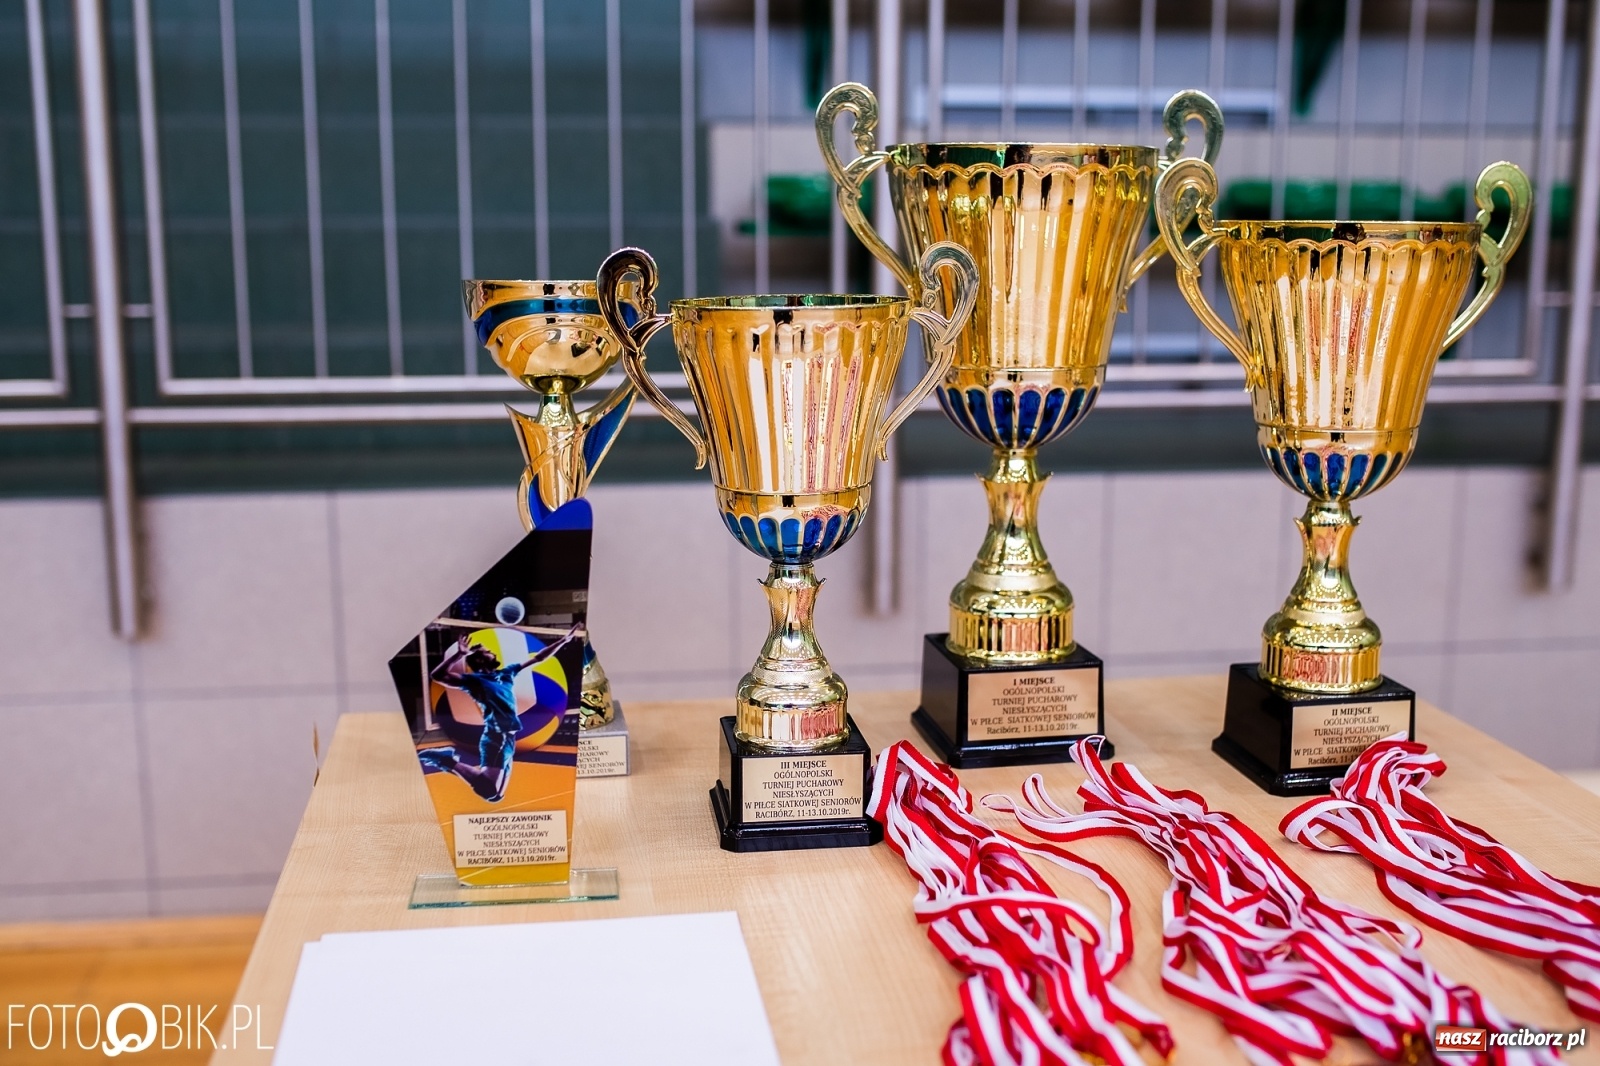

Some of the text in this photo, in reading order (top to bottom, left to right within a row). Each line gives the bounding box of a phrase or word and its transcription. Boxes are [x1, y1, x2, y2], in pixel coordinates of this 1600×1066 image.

[1019, 677, 1055, 686] MIEJSCE
[1003, 686, 1065, 695] OGÓLNOPOLSKI
[992, 695, 1077, 706] TURNIEJ PUCHAROWY
[1003, 705, 1067, 715] NIESŁYSZĄCYCH
[1340, 707, 1372, 715] MIEJSCE
[1008, 715, 1052, 723] SIATKOWEJ
[1053, 712, 1096, 721] SENIORÓW
[1324, 716, 1379, 726] OGÓLNOPOLSKI
[987, 723, 1079, 735] Racibórz, 11-13.10.2019r.
[1314, 725, 1390, 736] TURNIEJ PUCHAROWY
[1323, 735, 1380, 745] NIESŁYSZĄCYCH
[793, 760, 827, 769] MIEJSCE
[1308, 756, 1338, 765] Racibórz,
[774, 770, 833, 779] OGÓLNOPOLSKI
[797, 779, 844, 788] PUCHAROWY
[773, 789, 834, 799] NIESŁYSZĄCYCH
[754, 801, 775, 809] PIŁCE
[778, 799, 819, 808] SIATKOWEJ
[821, 796, 862, 805] SENIORÓW
[755, 808, 851, 819] RACIBÓRZ, 11-13.10.2019r.
[468, 814, 552, 824] NAJLEPSZY ZAWODNIK
[483, 823, 538, 831] OGÓLNOPOLSKI
[483, 839, 540, 848] NIESŁYSZĄCYCH
[488, 848, 527, 856] SIATKOWEJ
[528, 846, 565, 854] SENIORÓW
[468, 855, 556, 865] RACIBÓRZ, 11-13.10.2019r.
